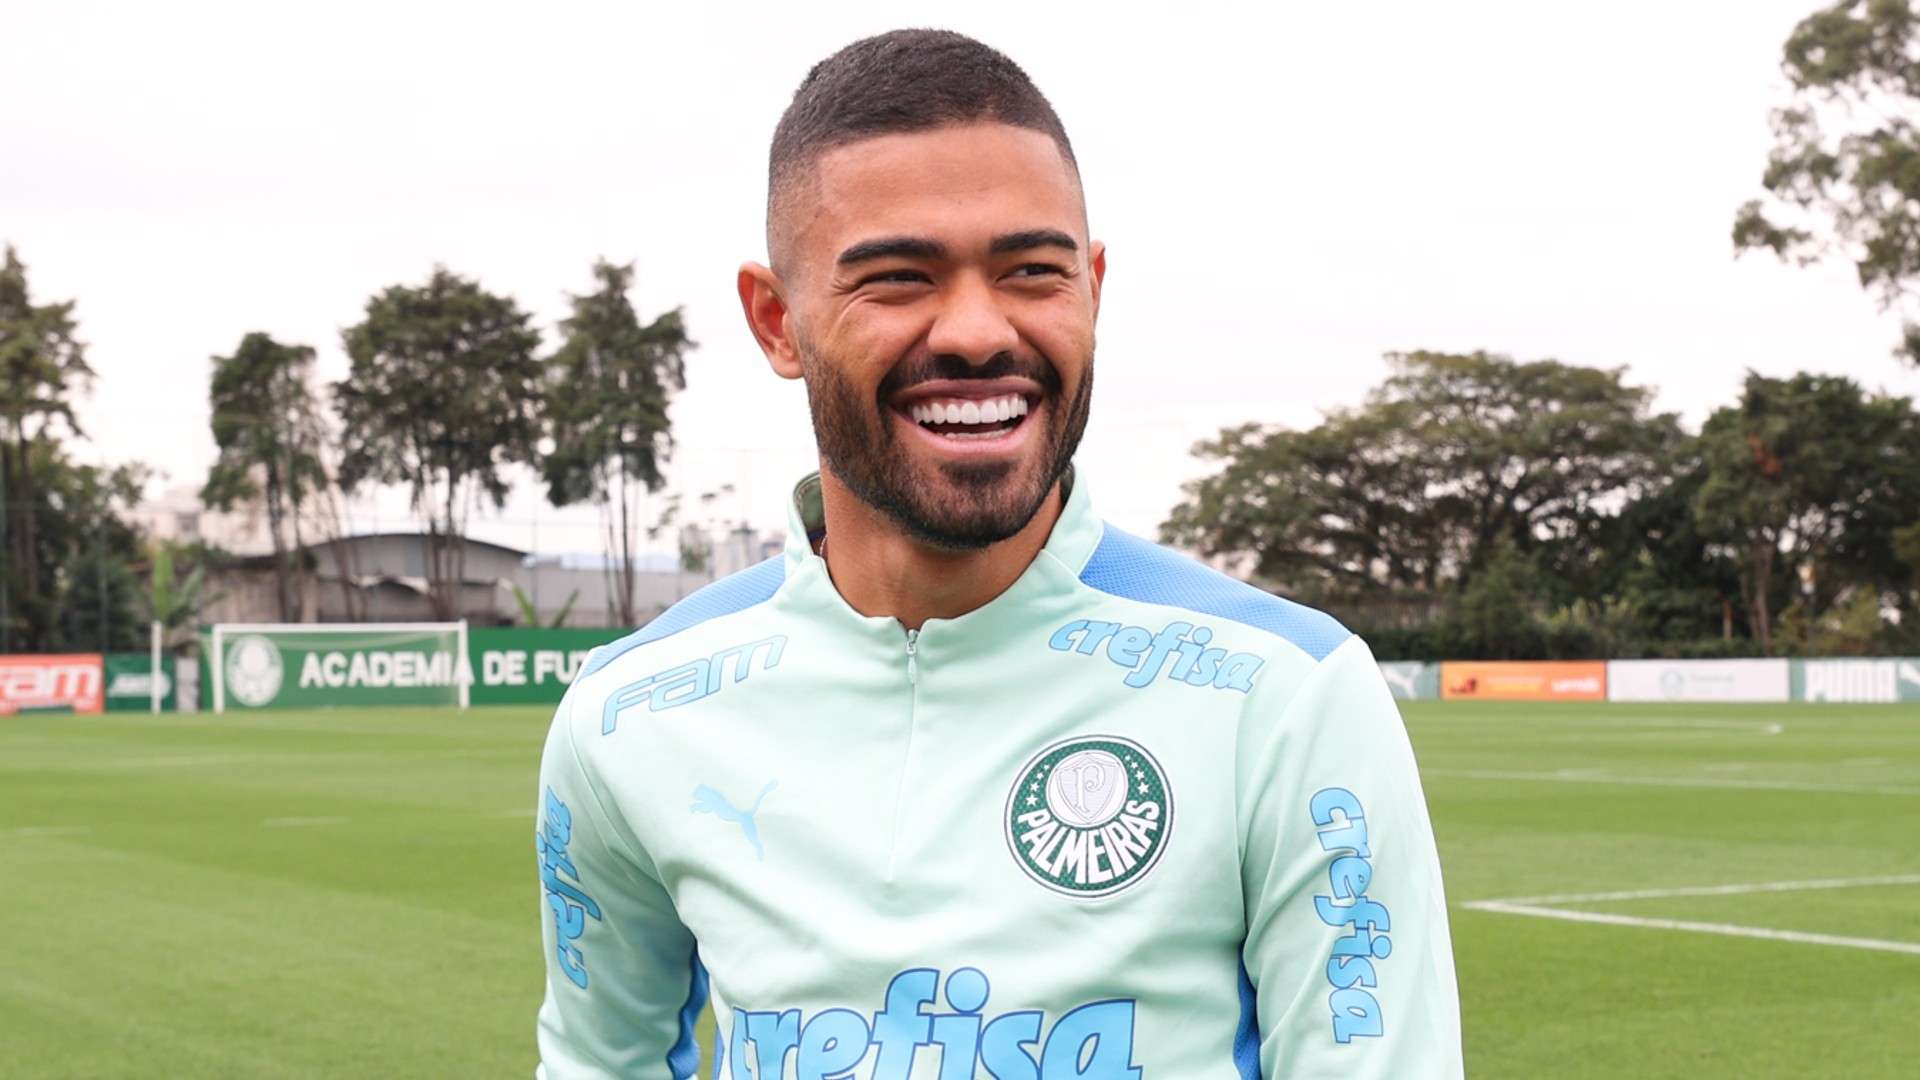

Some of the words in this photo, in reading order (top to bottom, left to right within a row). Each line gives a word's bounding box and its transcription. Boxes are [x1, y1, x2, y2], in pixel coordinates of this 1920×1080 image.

[0, 664, 101, 703] am
[299, 651, 475, 688] ACADEMIA
[482, 651, 527, 686] DE
[1048, 619, 1265, 693] crefisa
[1017, 800, 1160, 885] PALMEIRAS
[1310, 787, 1392, 1044] crefisa
[730, 967, 1143, 1080] crefisa
